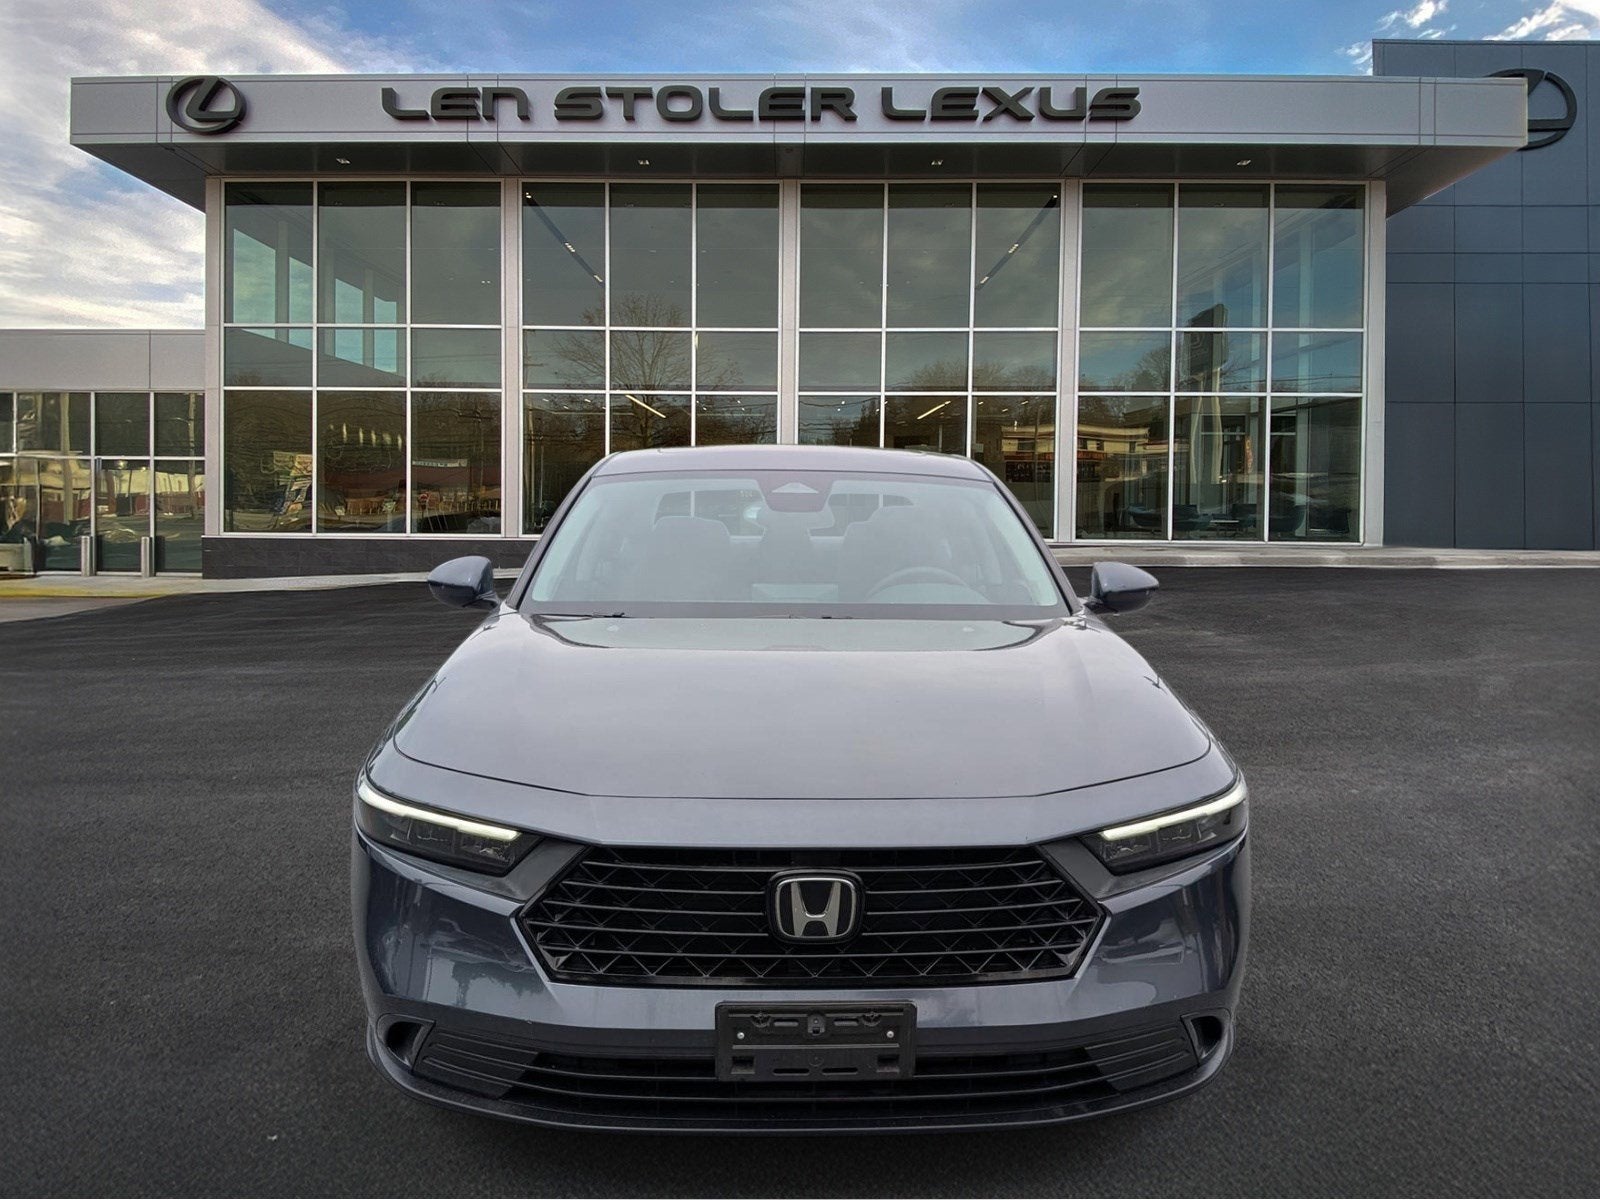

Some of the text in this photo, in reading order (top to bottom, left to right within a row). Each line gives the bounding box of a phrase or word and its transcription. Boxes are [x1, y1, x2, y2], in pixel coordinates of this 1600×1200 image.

[381, 85, 1142, 122] LEN STOLER LEXUS
